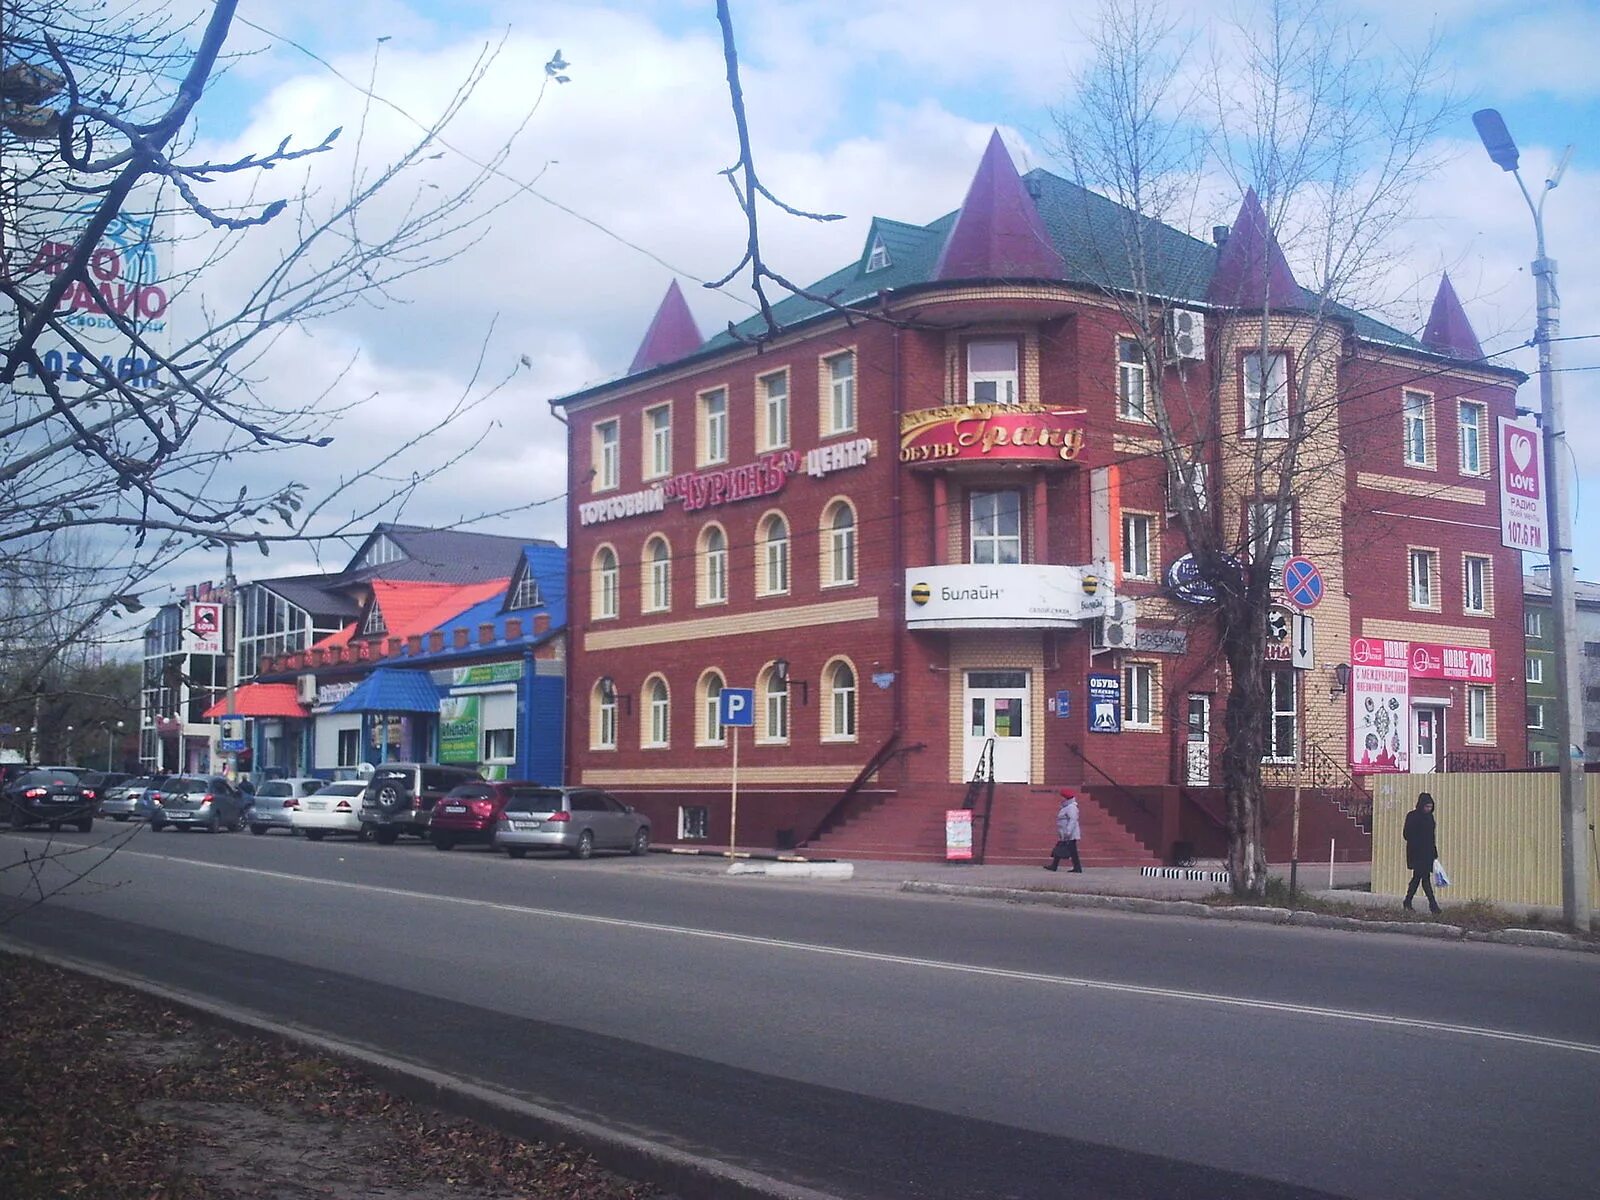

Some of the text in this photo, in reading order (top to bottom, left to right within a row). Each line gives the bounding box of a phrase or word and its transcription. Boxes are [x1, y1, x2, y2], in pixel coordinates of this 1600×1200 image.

[900, 441, 960, 463] ОБУВЬ
[579, 482, 665, 526] ТОРГОВЫЙ
[807, 438, 874, 478] ЦЕНТР
[1510, 473, 1535, 492] LOVE
[1510, 497, 1537, 512] РАДИО
[1508, 520, 1542, 548] 107.6 FM
[941, 585, 999, 601] Билайн
[1383, 640, 1409, 660] НОВОЕ
[1443, 648, 1469, 669] НОВОЕ
[1469, 651, 1493, 678] 2013
[1090, 678, 1119, 689] ОБУВЬ
[728, 694, 746, 720] P
